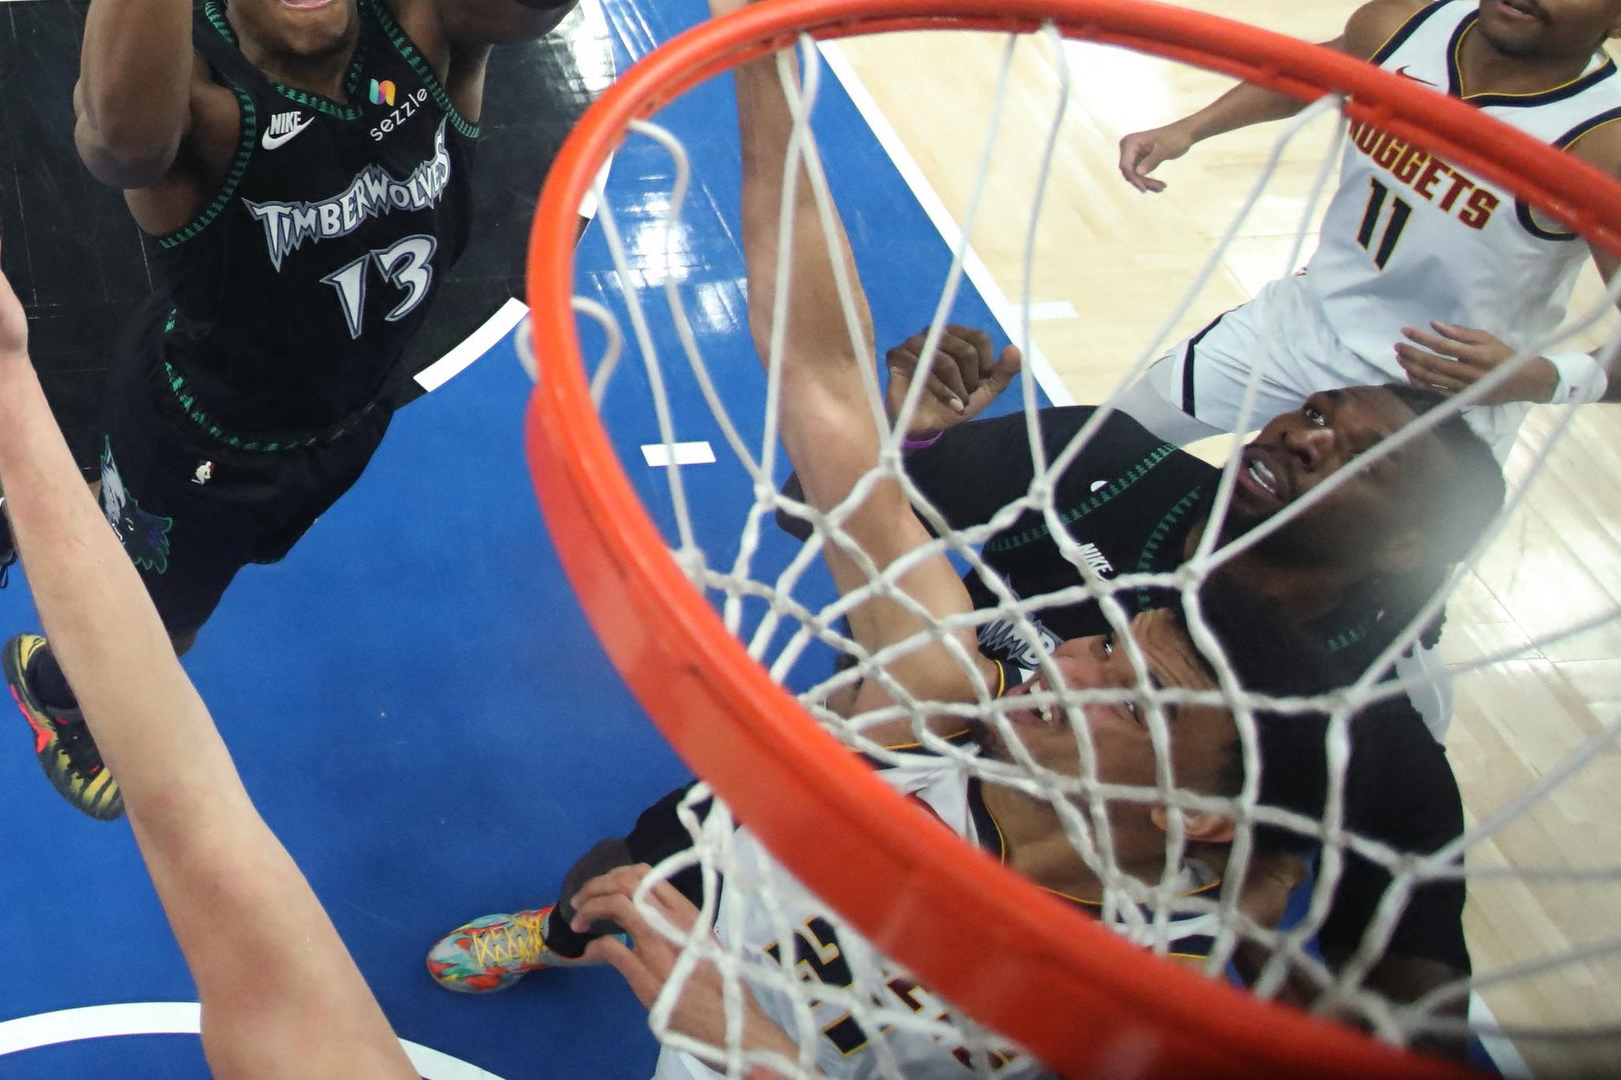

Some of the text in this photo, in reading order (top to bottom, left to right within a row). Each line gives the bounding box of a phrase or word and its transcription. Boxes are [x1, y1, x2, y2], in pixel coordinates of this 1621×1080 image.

[270, 110, 302, 135] NIKE
[369, 87, 428, 142] sezzle
[242, 114, 451, 273] TIMBERWOLVES
[1349, 117, 1501, 230] UGGETS
[1356, 174, 1413, 272] 11
[319, 233, 437, 340] 13
